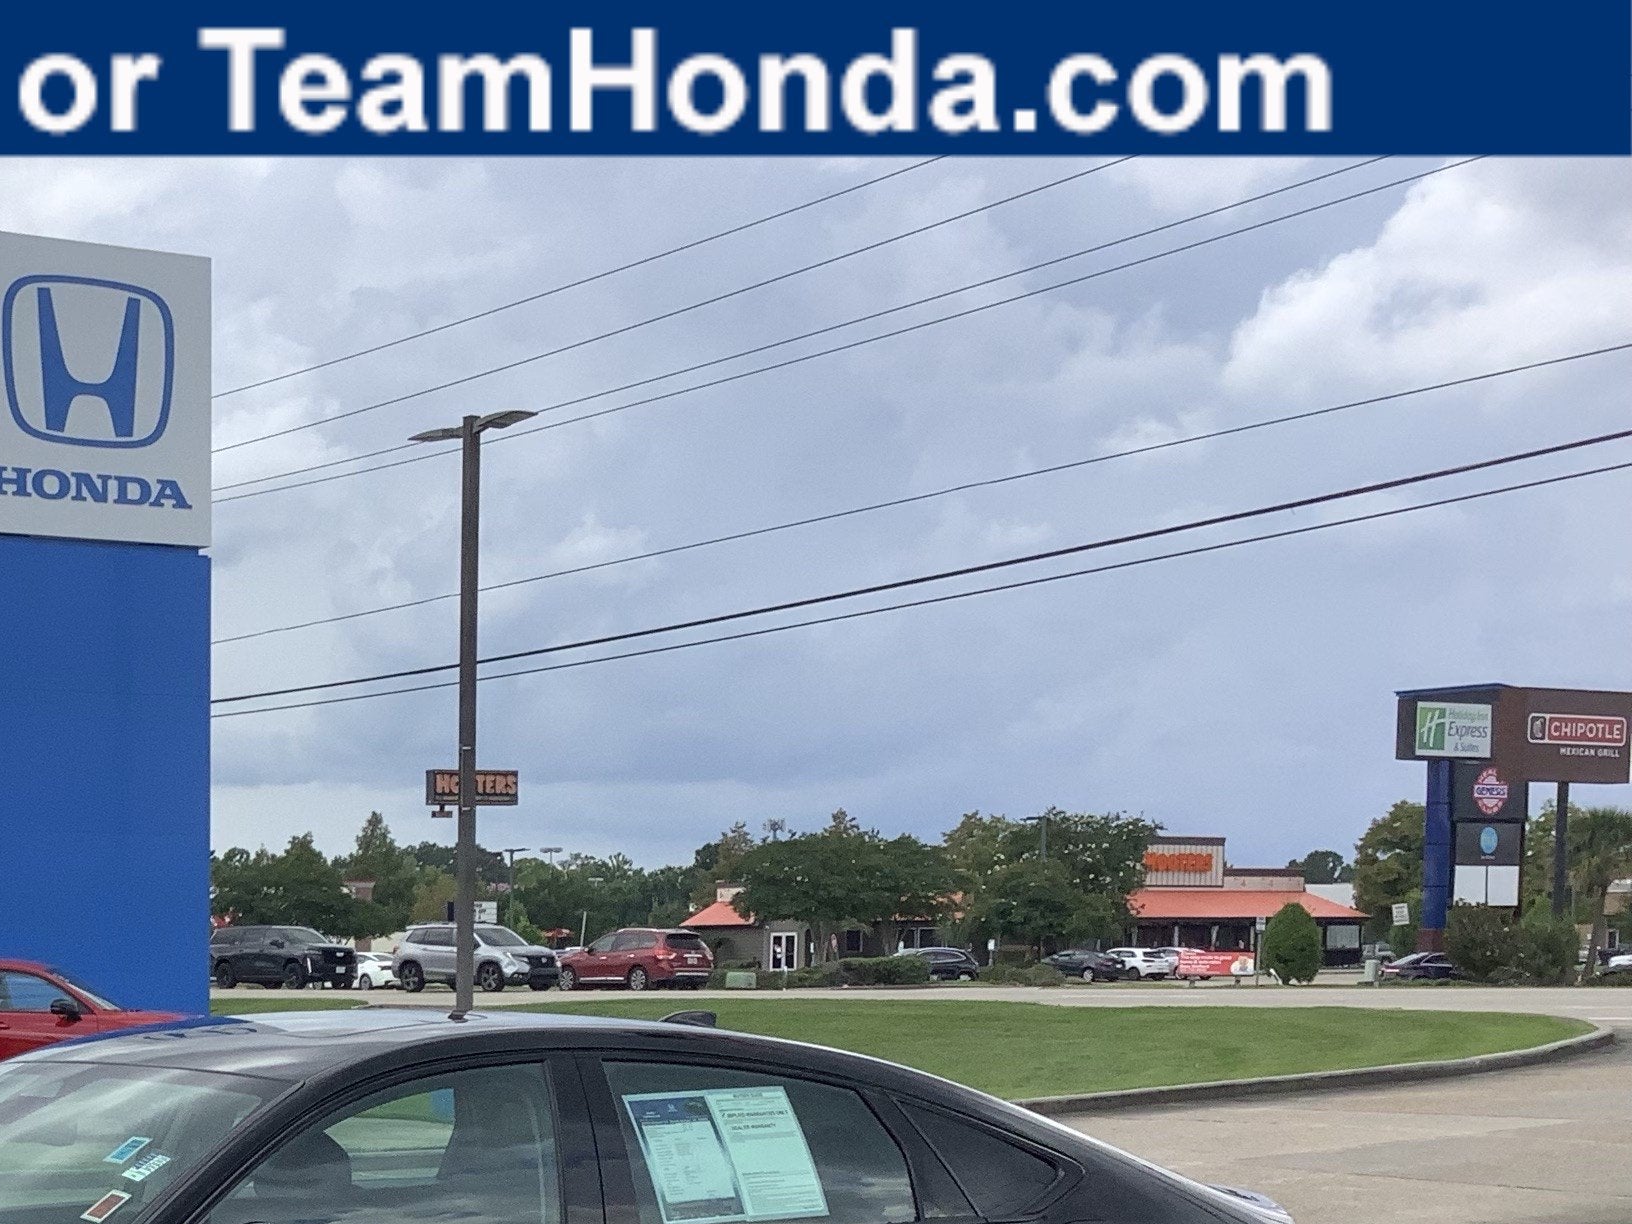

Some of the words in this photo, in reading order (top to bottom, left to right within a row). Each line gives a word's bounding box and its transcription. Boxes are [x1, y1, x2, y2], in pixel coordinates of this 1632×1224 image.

[1447, 720, 1489, 741] Express
[1551, 721, 1622, 739] CHIPOTLE
[1560, 747, 1595, 757] MEXICAN
[1597, 748, 1620, 758] GRILL
[435, 773, 517, 795] HOTERS
